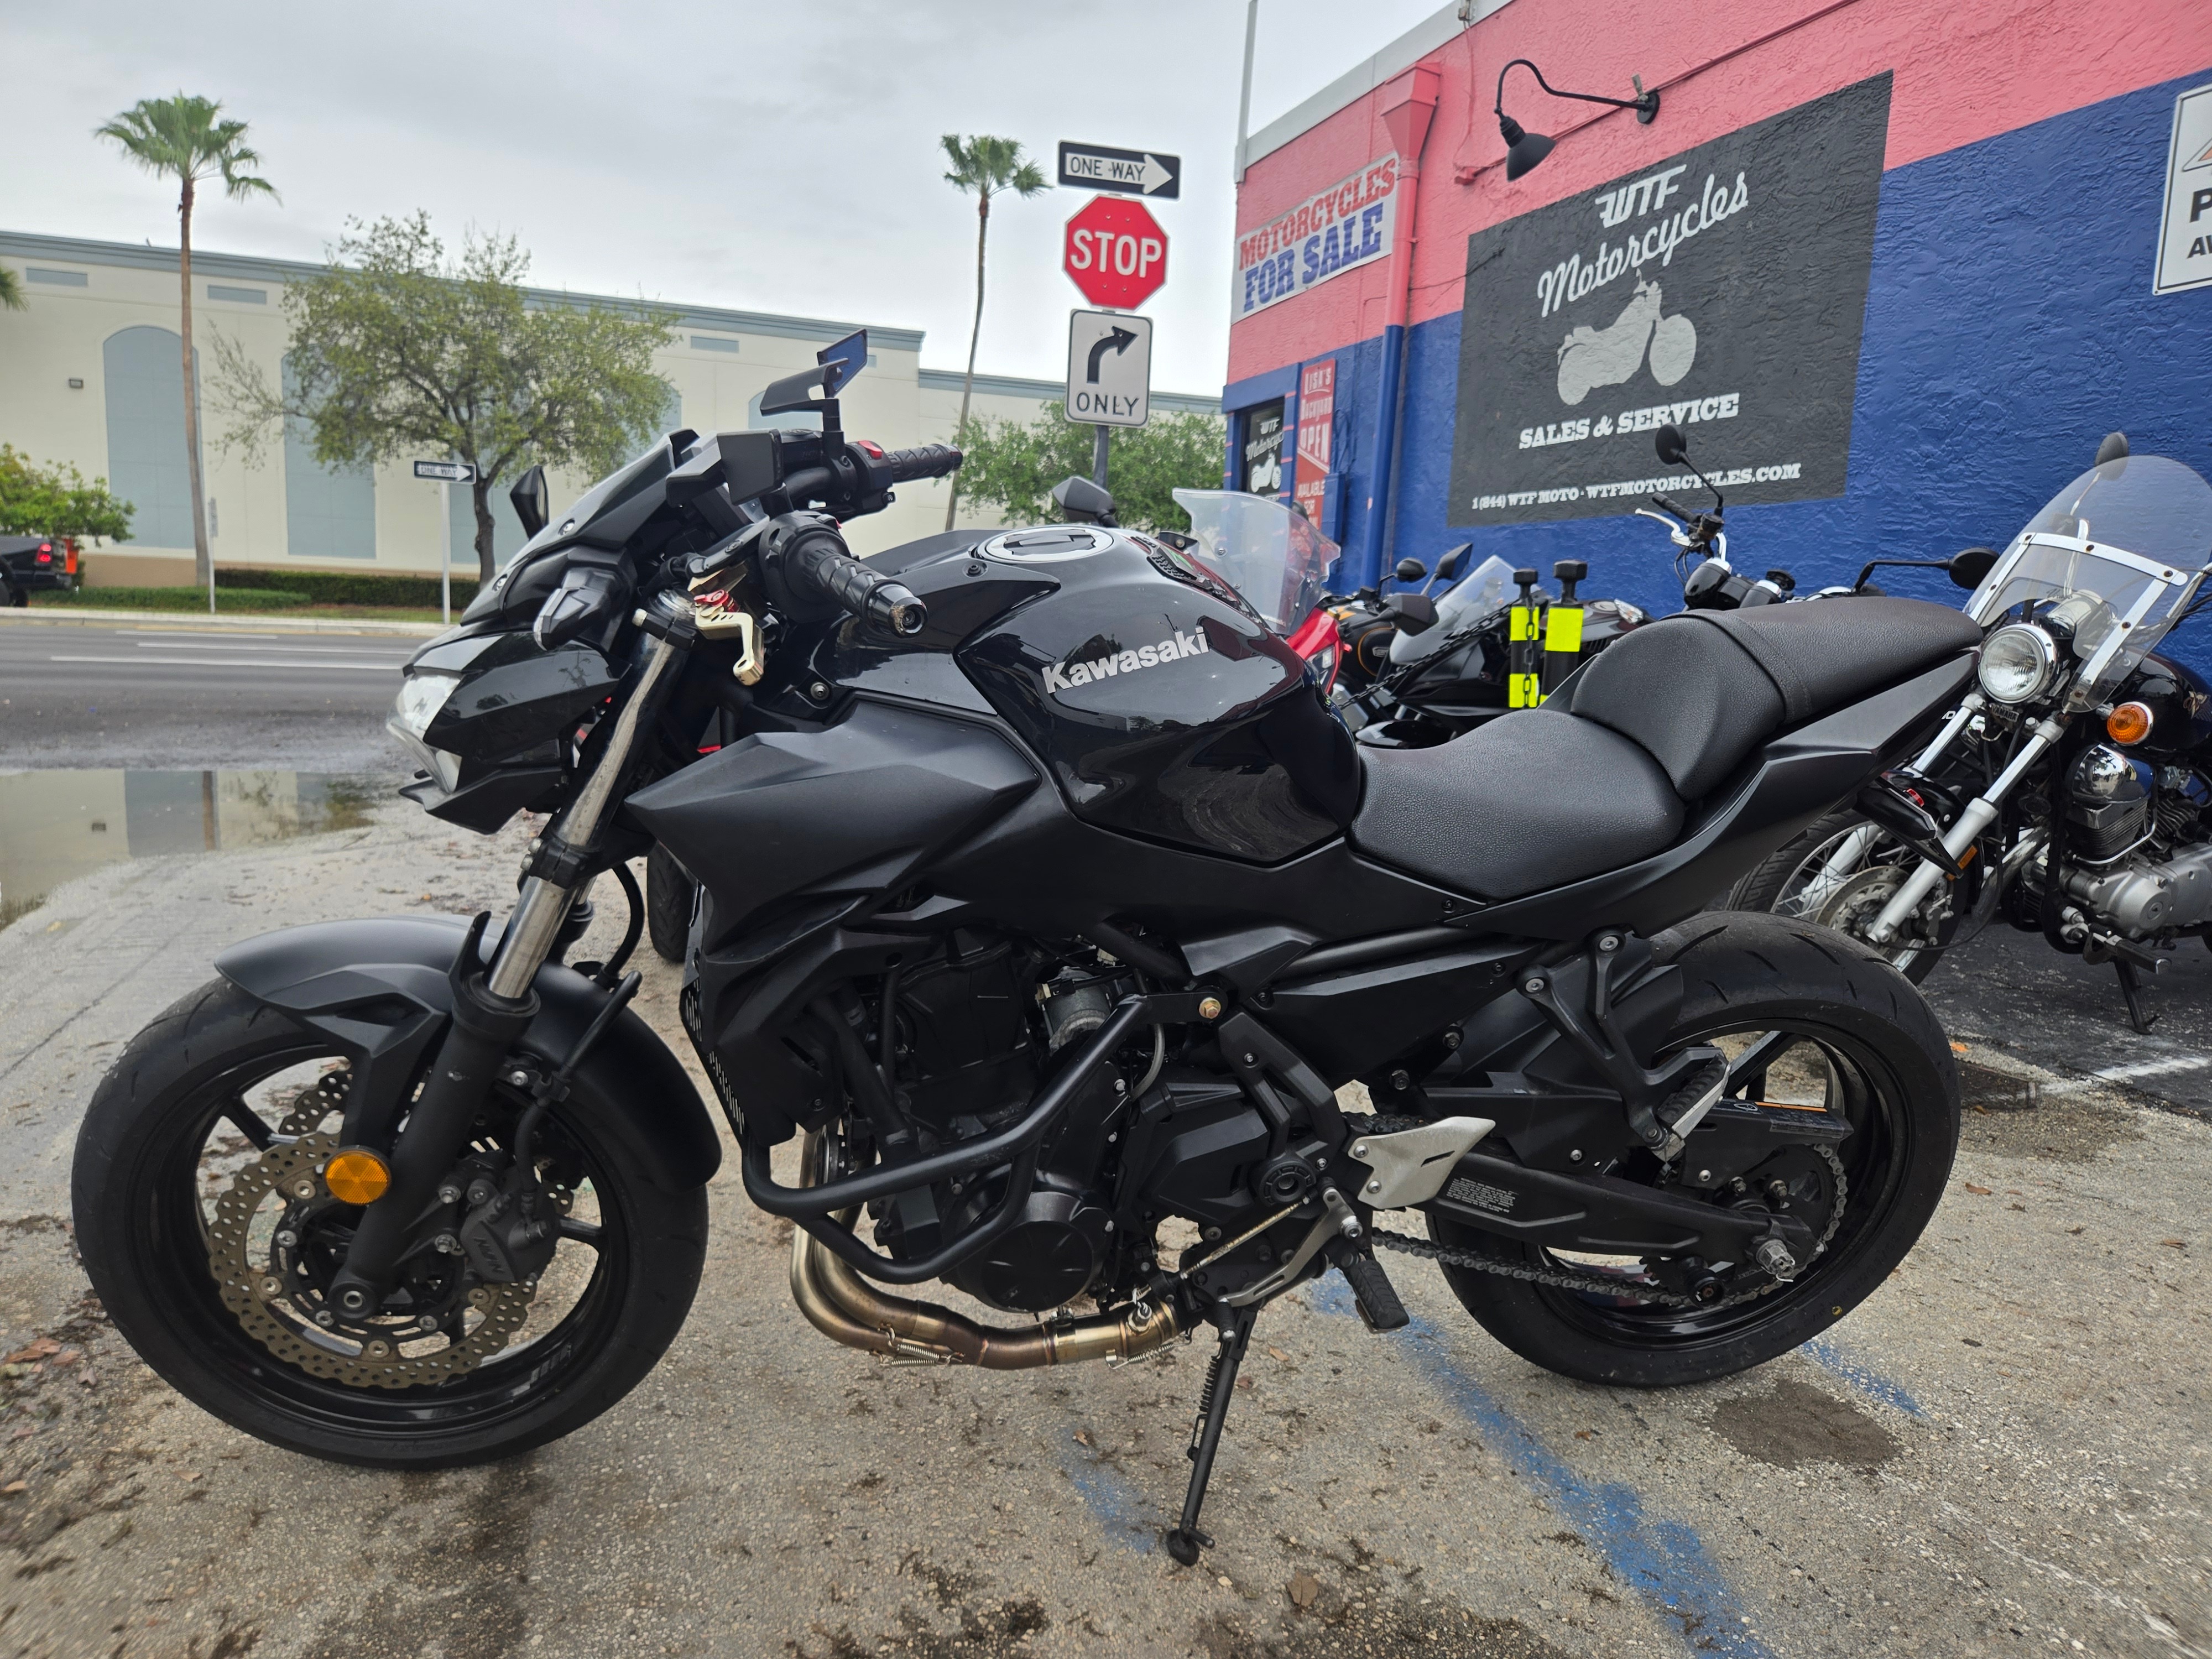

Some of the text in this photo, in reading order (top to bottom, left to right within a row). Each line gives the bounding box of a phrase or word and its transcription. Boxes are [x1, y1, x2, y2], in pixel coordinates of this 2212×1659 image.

[1070, 156, 1146, 182] ONE WAY
[1239, 158, 1396, 271] MOTORCYCLES
[1595, 164, 1687, 228] WTF
[1070, 229, 1162, 278] STOP
[1244, 202, 1385, 313] FOR SALE
[1537, 172, 1748, 317] Motorcycles
[1077, 392, 1140, 416] ONLY
[1519, 392, 1740, 449] SALES & SERVICE
[1300, 423, 1330, 463] OPEN
[420, 466, 457, 477] ONE WAY
[1508, 491, 1537, 506] WTF
[1538, 487, 1579, 504] MOTO
[1585, 462, 1802, 499] WTFMOTORCYCLES.COM
[1042, 625, 1209, 695] Kawasaki
